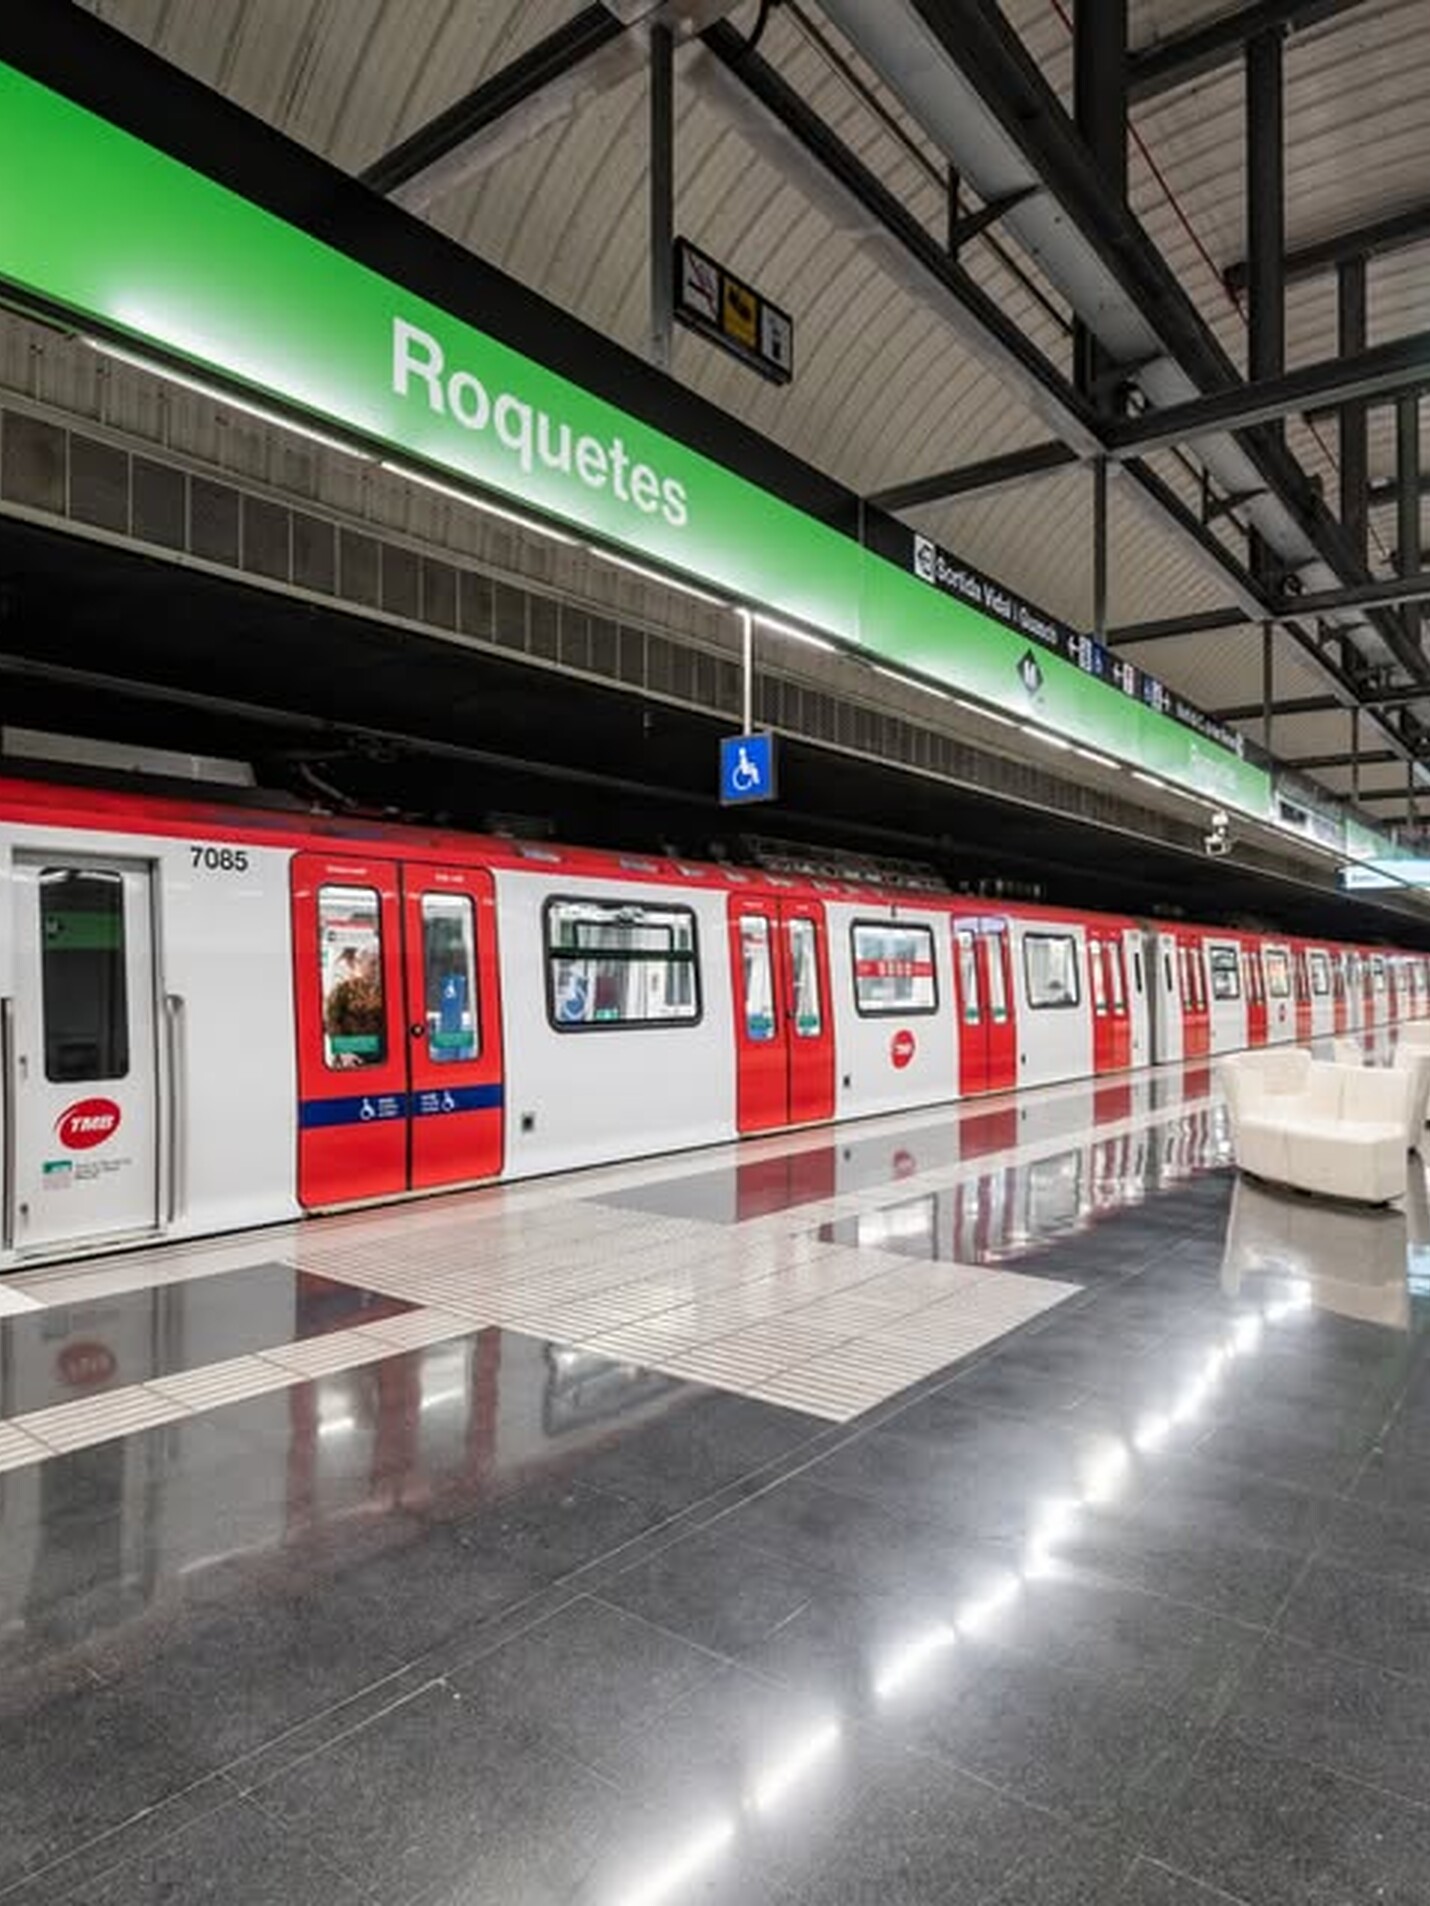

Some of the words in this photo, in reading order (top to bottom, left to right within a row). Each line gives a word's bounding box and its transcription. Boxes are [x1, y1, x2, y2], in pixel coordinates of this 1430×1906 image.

[392, 316, 688, 527] Roquetes
[935, 556, 982, 602] Sortida
[982, 582, 1012, 620] Vidal
[190, 845, 249, 872] 7085
[69, 1113, 116, 1133] TMB
